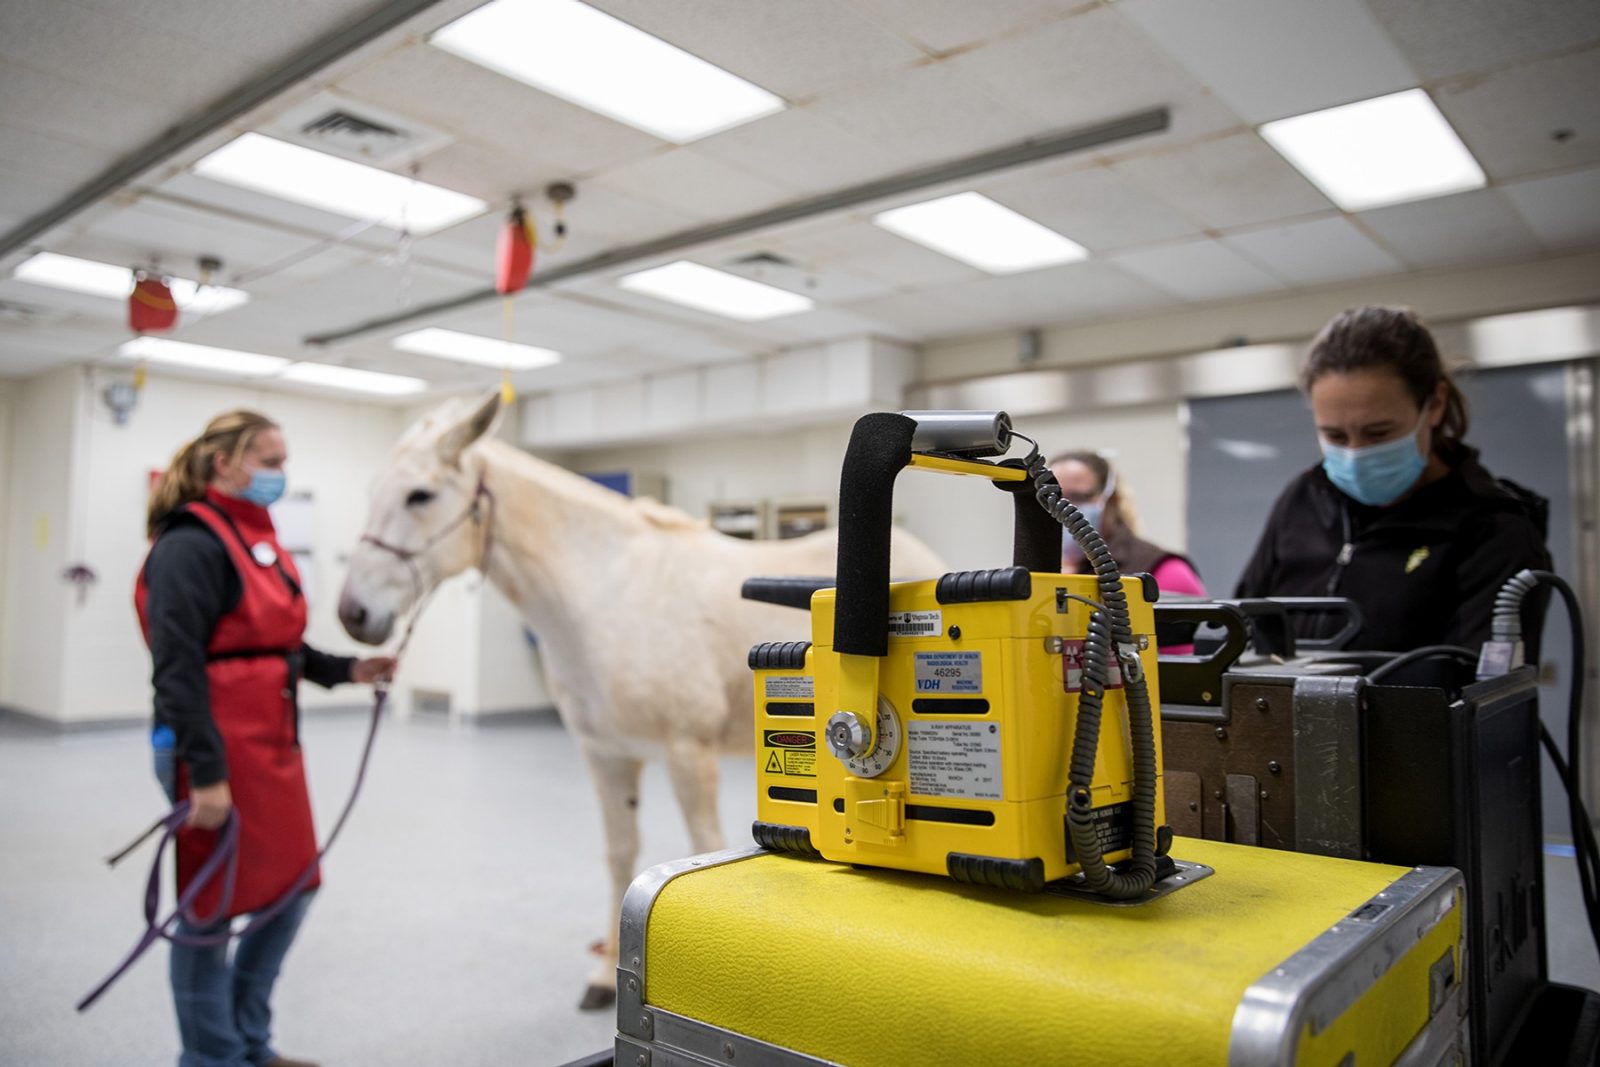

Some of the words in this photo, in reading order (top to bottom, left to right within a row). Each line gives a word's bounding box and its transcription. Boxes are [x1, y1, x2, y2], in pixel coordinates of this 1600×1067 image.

[934, 668, 961, 677] 46295
[918, 680, 940, 689] VDH
[777, 735, 807, 744] DANGER
